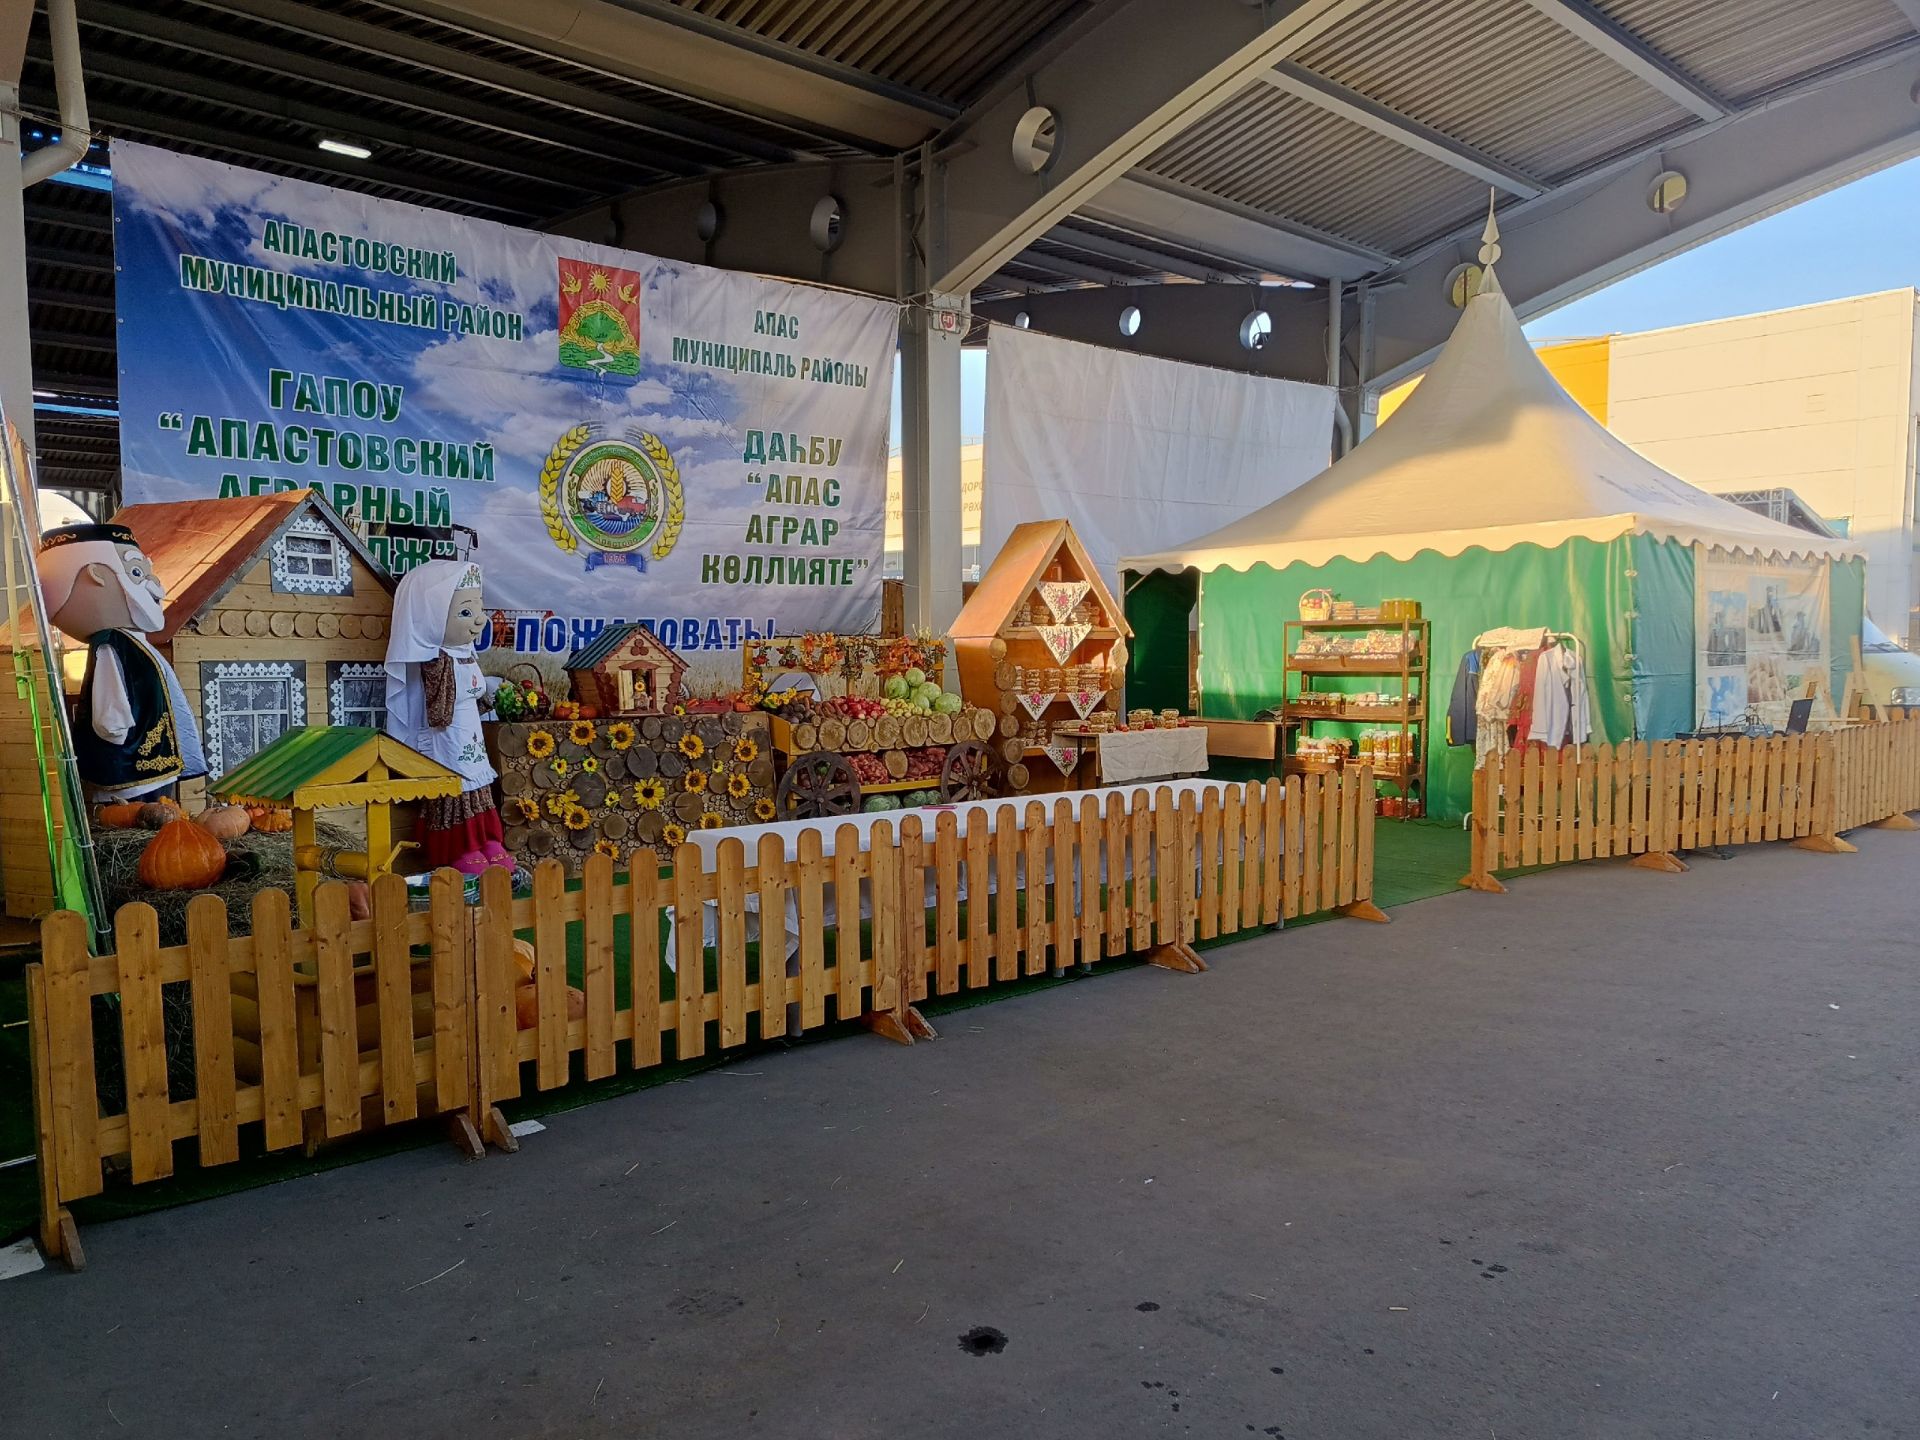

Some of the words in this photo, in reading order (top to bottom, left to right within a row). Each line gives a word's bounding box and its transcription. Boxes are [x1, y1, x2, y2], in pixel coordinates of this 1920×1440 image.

[262, 218, 458, 286] АПАСТОВСКИЙ
[179, 254, 437, 330] МУНИЦИПАЛЬНЫЙ
[442, 303, 524, 342] РАЙОН
[753, 309, 800, 341] АПАС
[672, 336, 797, 380] МУНИЦИПАЛЬ
[800, 355, 869, 390] РАЙОНЫ
[268, 367, 404, 423] ГАПОУ
[218, 472, 453, 529] АГРНЫЙ
[745, 513, 839, 547] АГРАР
[515, 616, 776, 654] ПОЖОВАТЬ!
